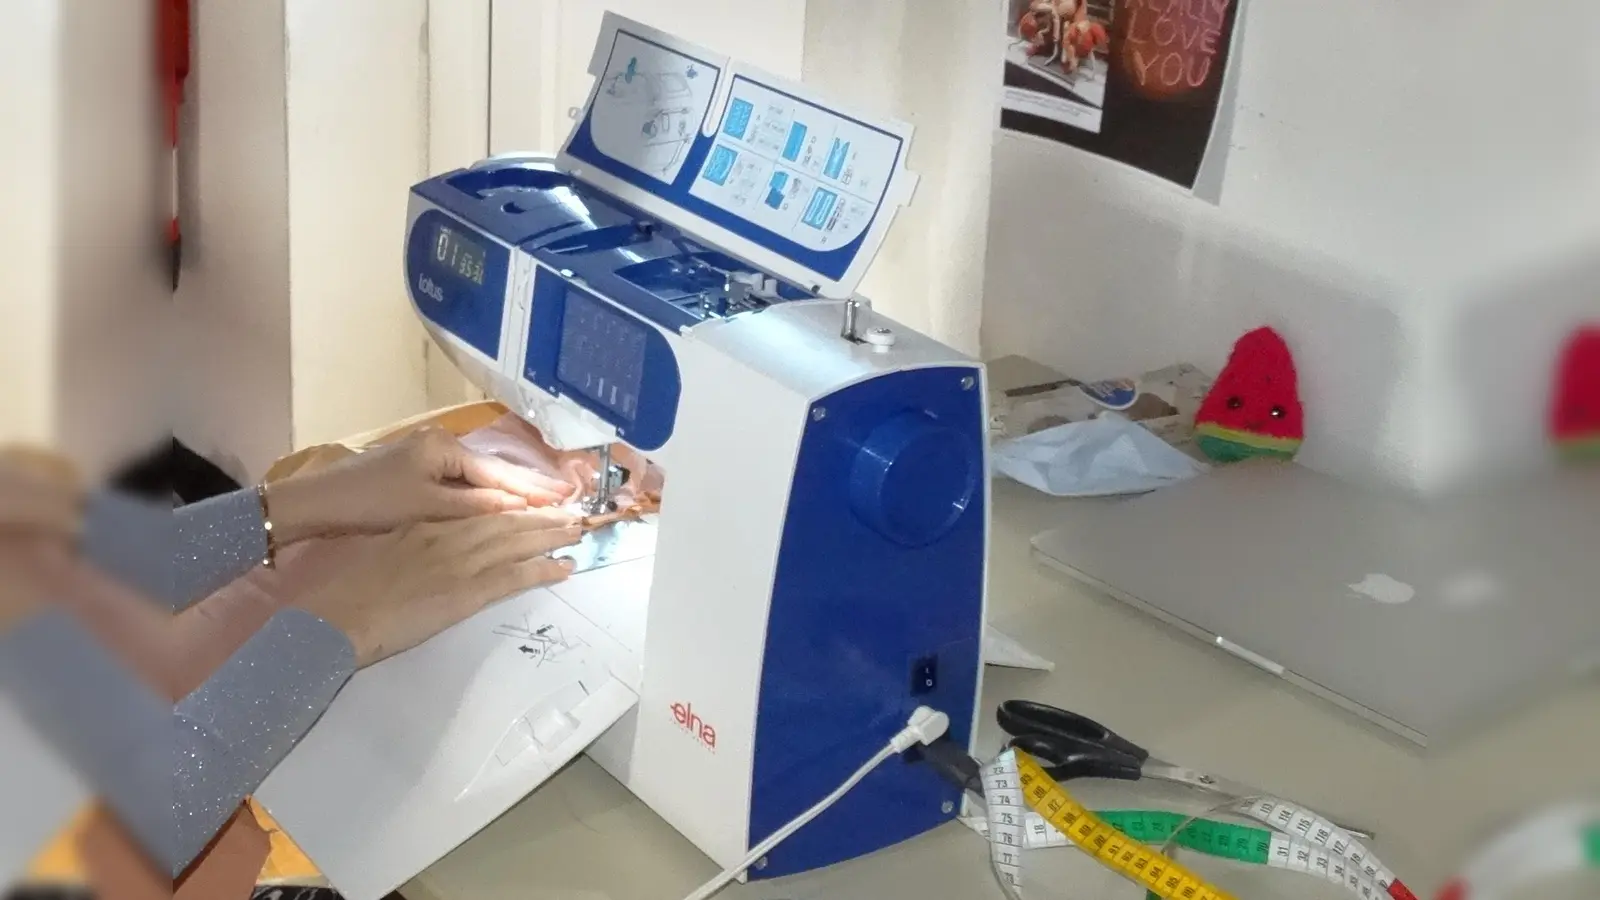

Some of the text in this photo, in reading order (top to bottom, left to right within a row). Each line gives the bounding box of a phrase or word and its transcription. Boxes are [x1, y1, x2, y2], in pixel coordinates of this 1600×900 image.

[1127, 10, 1221, 54] LOVE
[1132, 49, 1211, 87] YOU
[419, 272, 444, 302] lotus
[670, 702, 716, 748] elna
[995, 779, 1008, 789] 73
[999, 794, 1011, 805] 74
[1002, 812, 1013, 825] 75
[1278, 809, 1292, 822] 114
[1034, 823, 1045, 835] 18
[1296, 818, 1310, 832] 115
[1002, 832, 1013, 845] 76
[1107, 844, 1121, 855] 91
[1276, 846, 1289, 857] 31
[1332, 840, 1345, 856] 117
[1003, 852, 1013, 863] 77
[1297, 850, 1309, 862] 32
[1316, 856, 1328, 869] 33
[1149, 866, 1163, 880] 94
